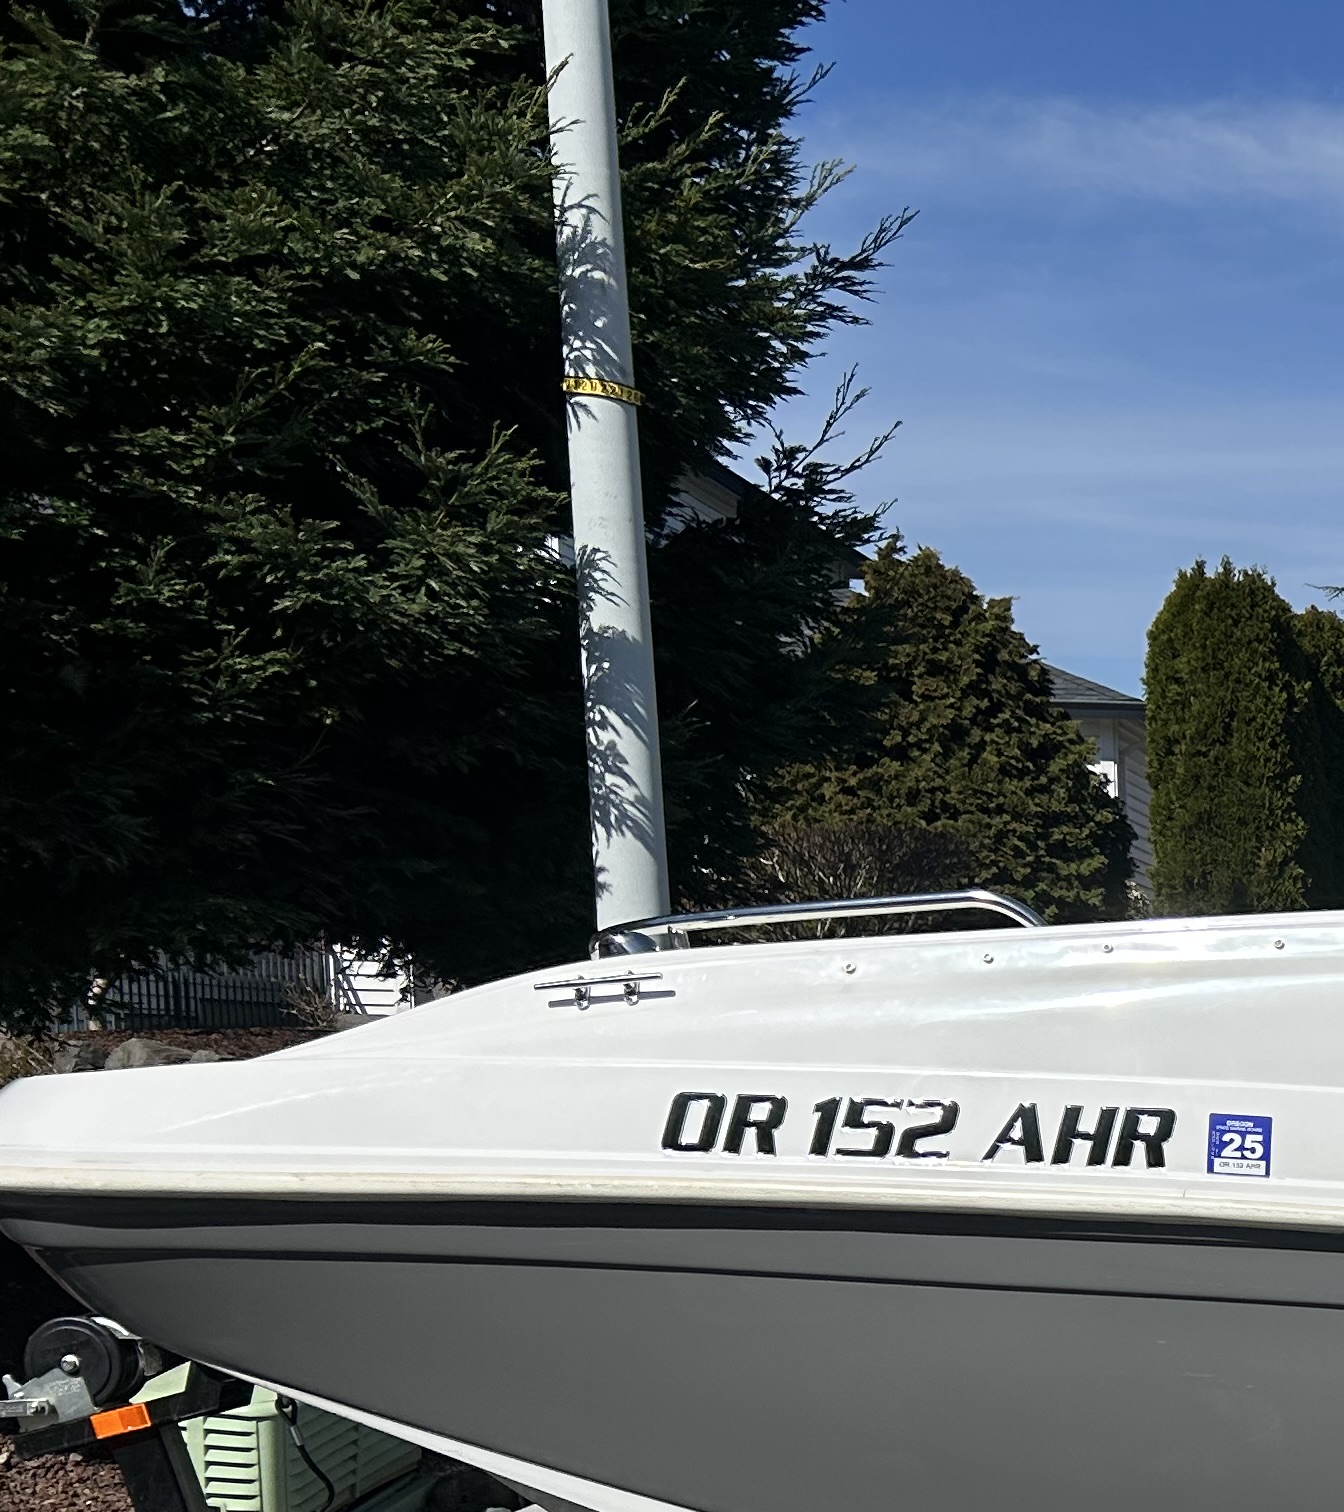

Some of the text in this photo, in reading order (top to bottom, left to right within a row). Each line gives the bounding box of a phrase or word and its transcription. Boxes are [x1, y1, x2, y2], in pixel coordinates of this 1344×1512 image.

[661, 1091, 788, 1156] OR
[807, 1096, 961, 1162] 152
[981, 1102, 1178, 1169] AHR
[1220, 1132, 1264, 1159] 25
